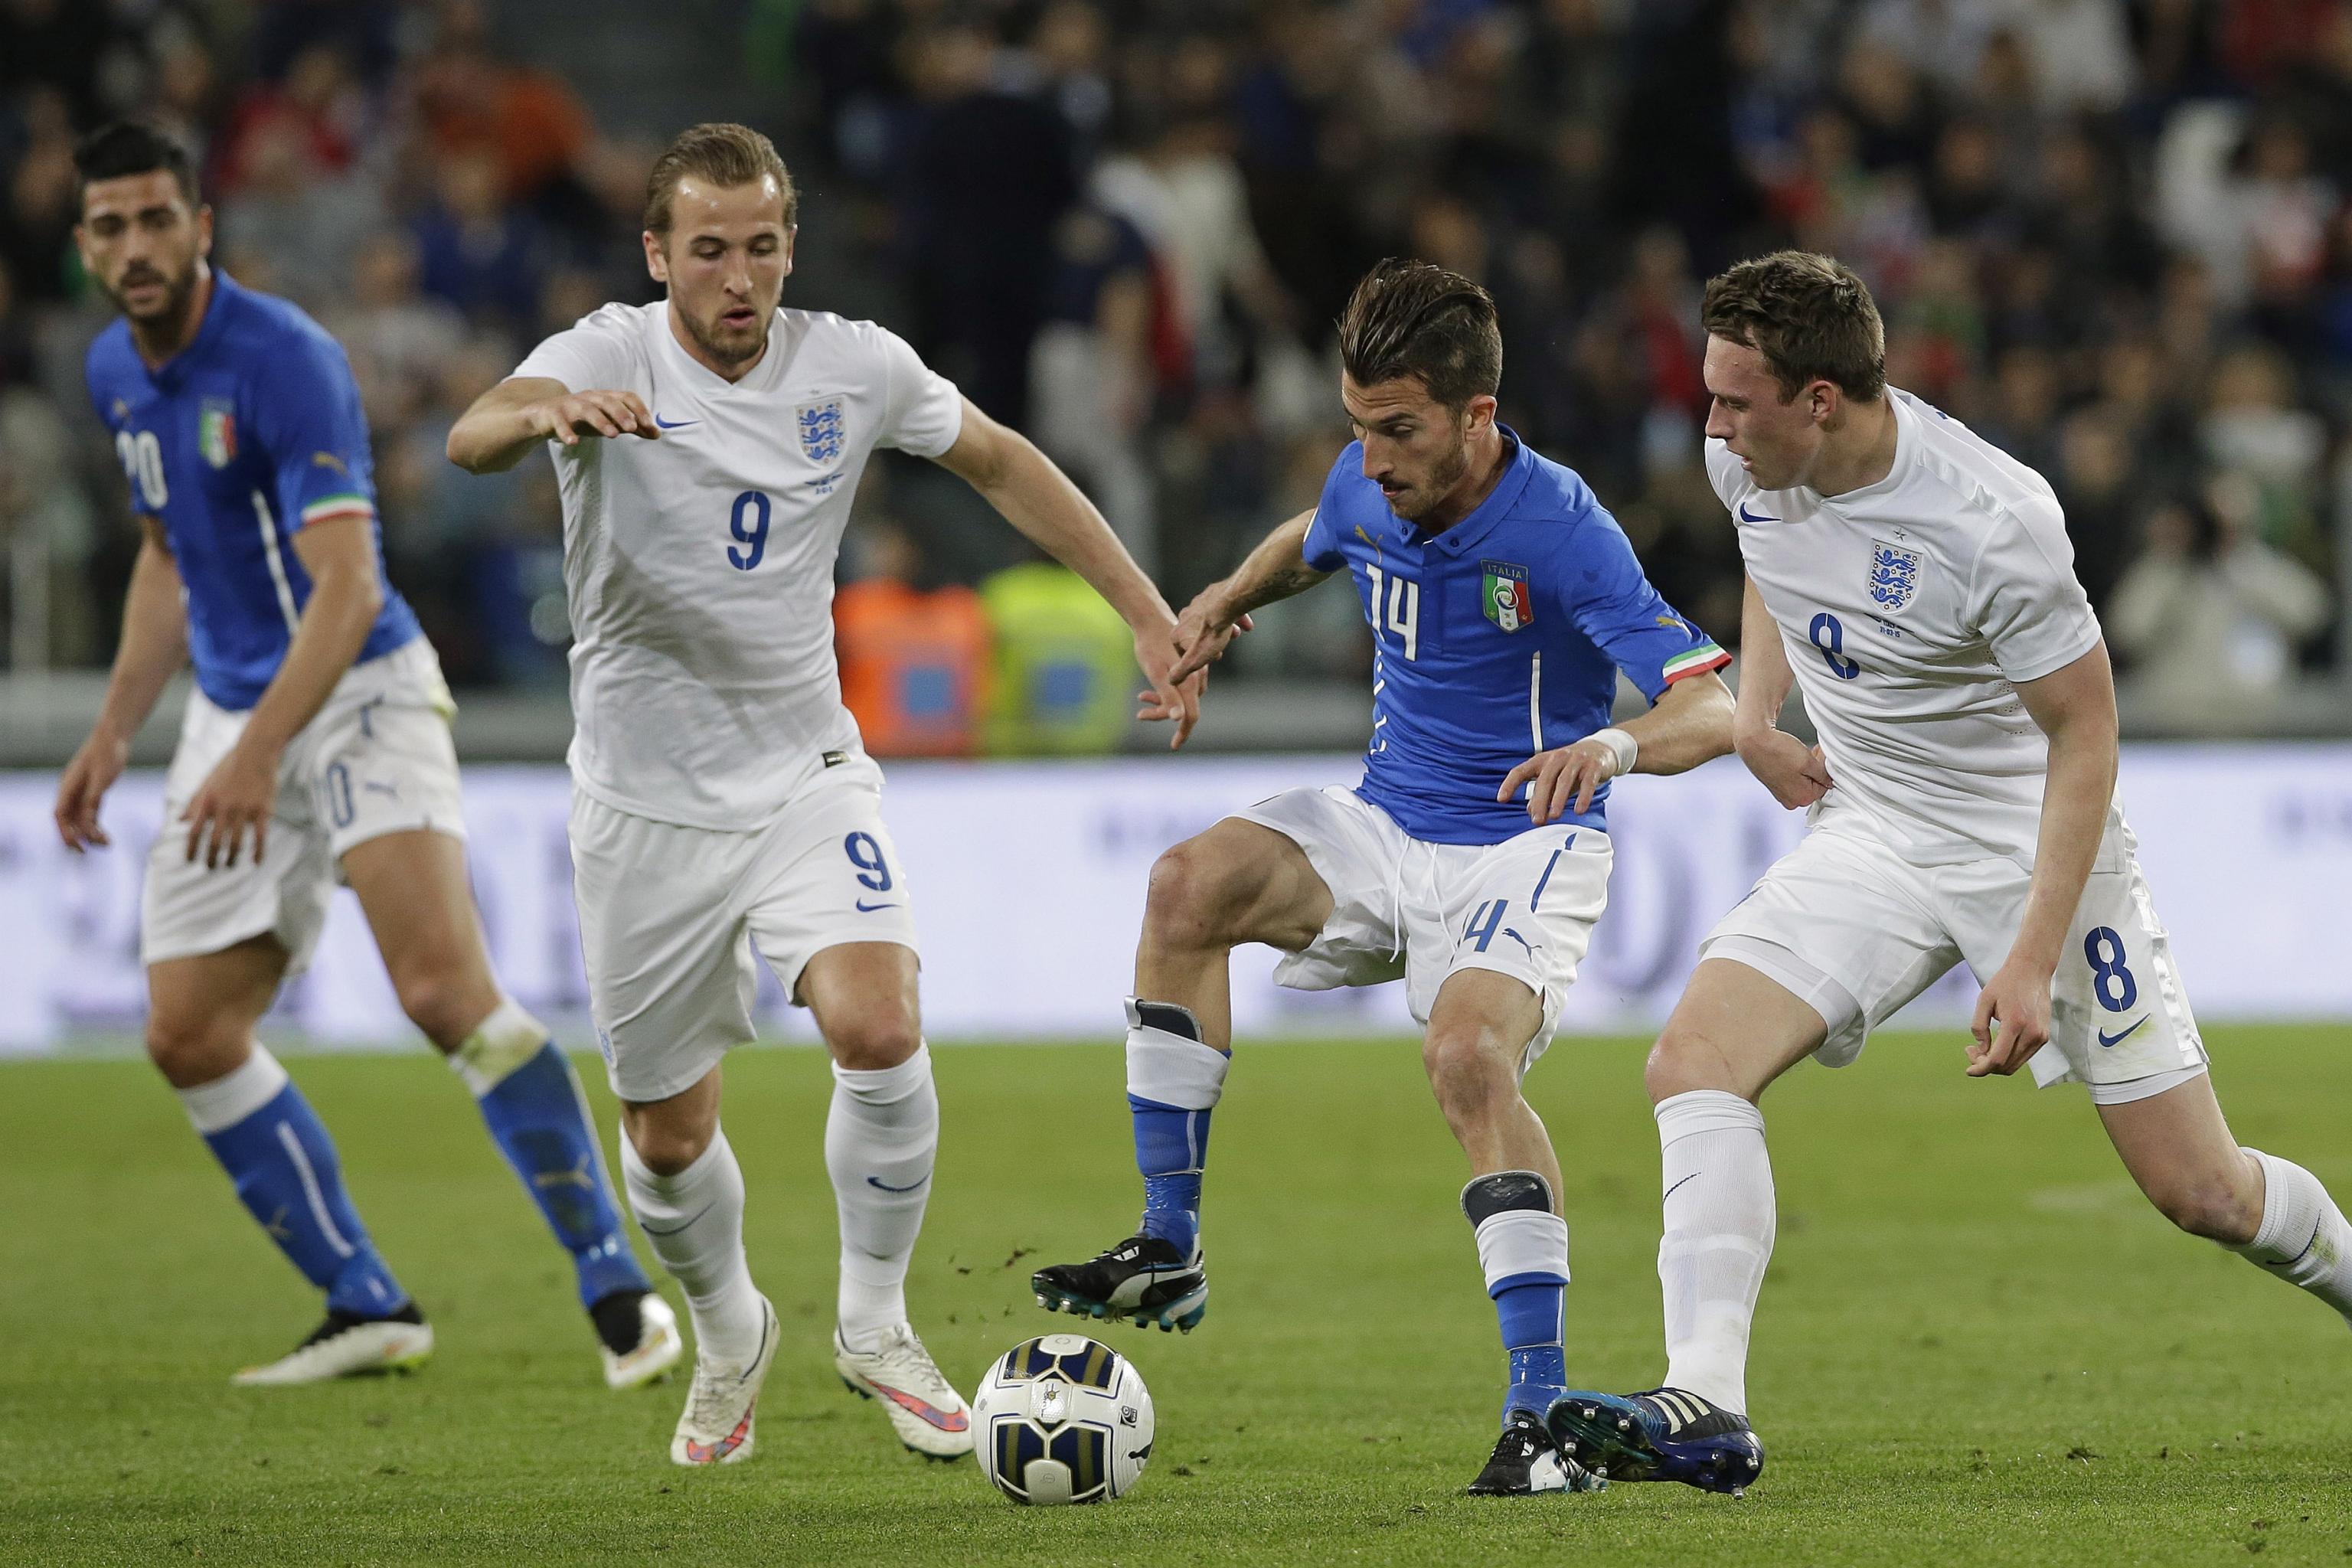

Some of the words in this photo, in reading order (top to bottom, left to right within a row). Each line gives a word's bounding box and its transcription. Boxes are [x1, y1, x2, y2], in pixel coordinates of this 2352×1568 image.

[727, 490, 770, 570] 9
[1488, 564, 1522, 579] ITALIA
[1366, 562, 1419, 662] 14
[325, 763, 355, 828] 0
[844, 831, 892, 891] 9
[2084, 926, 2138, 1012] 8
